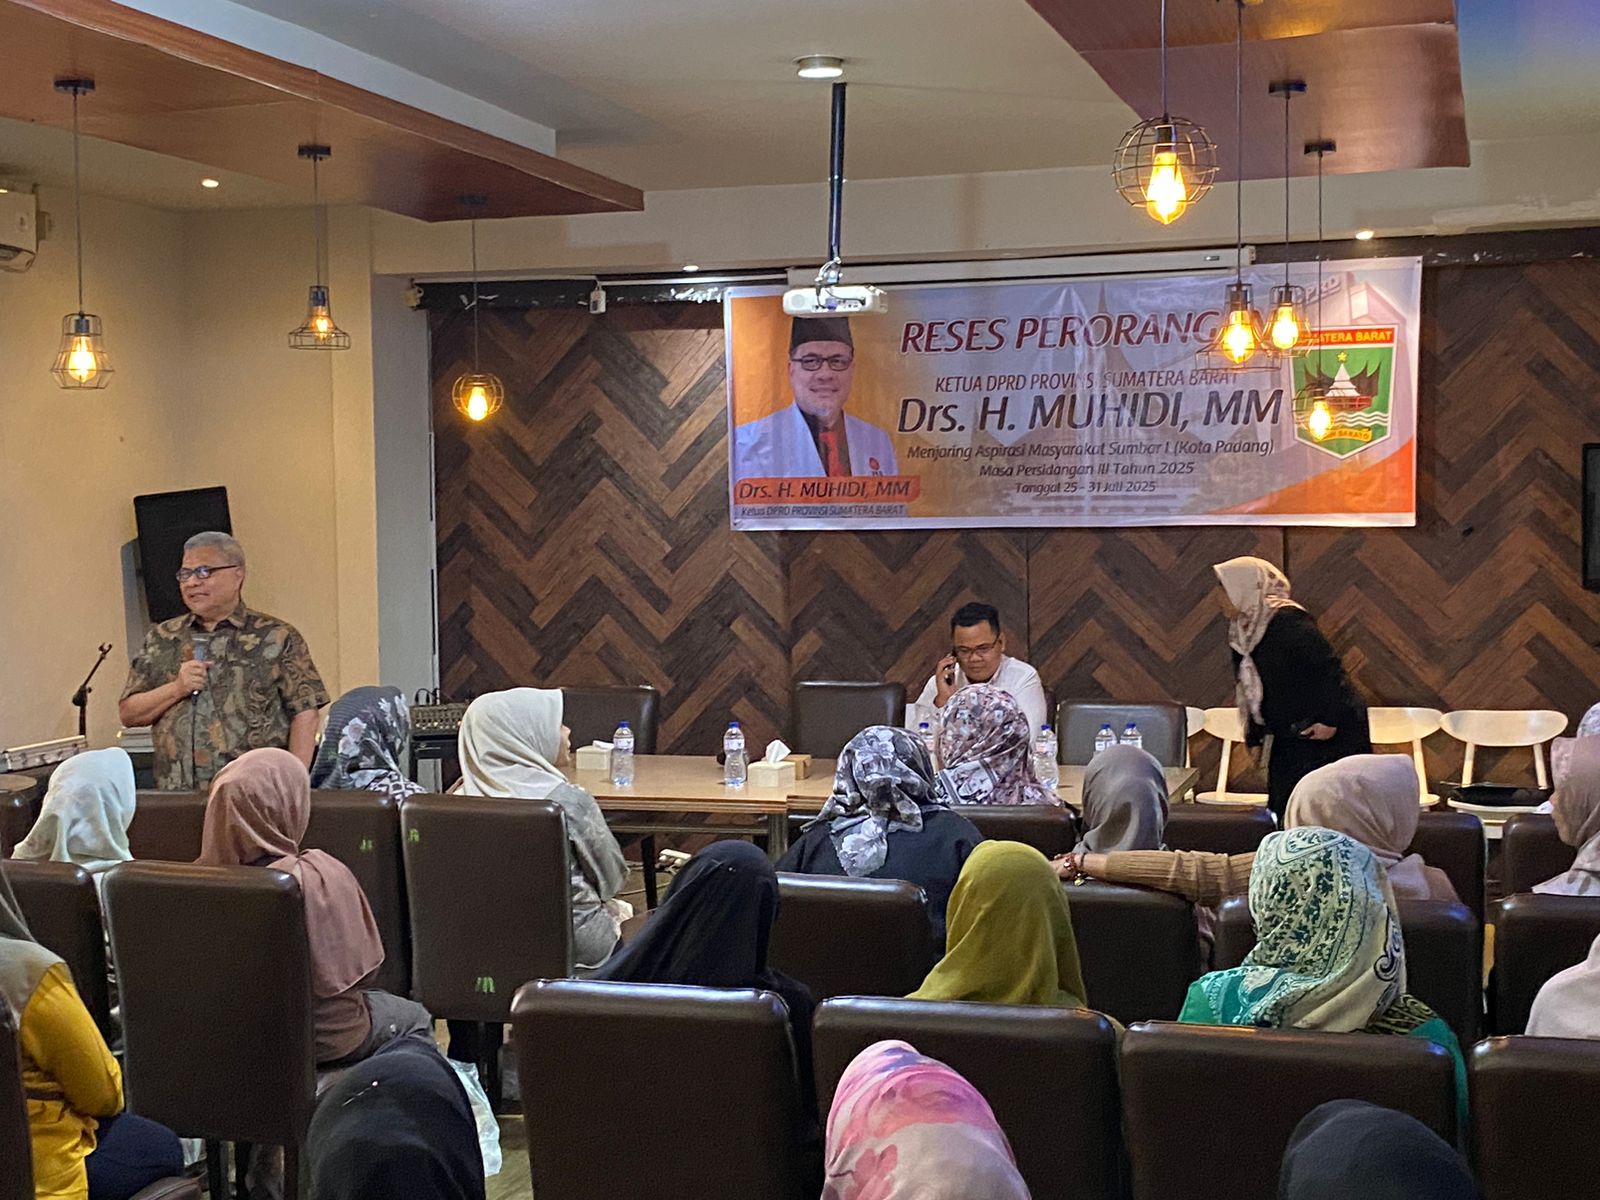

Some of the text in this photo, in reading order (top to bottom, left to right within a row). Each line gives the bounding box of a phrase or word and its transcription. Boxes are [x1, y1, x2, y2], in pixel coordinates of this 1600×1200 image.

[902, 319, 1006, 352] RESES
[1356, 331, 1392, 341] BARAT
[936, 376, 981, 392] KETUA
[986, 374, 1026, 390] DPRD
[1103, 370, 1185, 388] SUMATERA
[1189, 368, 1238, 386] BARAT
[898, 389, 1284, 433] Drs. H. MUHIDI, MM
[907, 445, 972, 461] Menjaring
[975, 443, 1026, 460] Aspirasi
[1028, 442, 1104, 459] Masyarakat
[1109, 441, 1161, 455] Sumbar
[1174, 440, 1210, 456] (Kota
[1215, 440, 1274, 456] Padang)
[979, 461, 1195, 479] Masa Persidangan III Tahun 2025
[740, 480, 911, 499] Drs. H. MUHIDI, MM
[1015, 482, 1060, 496] Tanggal
[1064, 481, 1079, 493] 25
[1087, 481, 1101, 492] 31
[1125, 480, 1156, 492] 2025
[741, 504, 904, 516] Ketua DPRD PROVINSI SUMATERA BARAT
